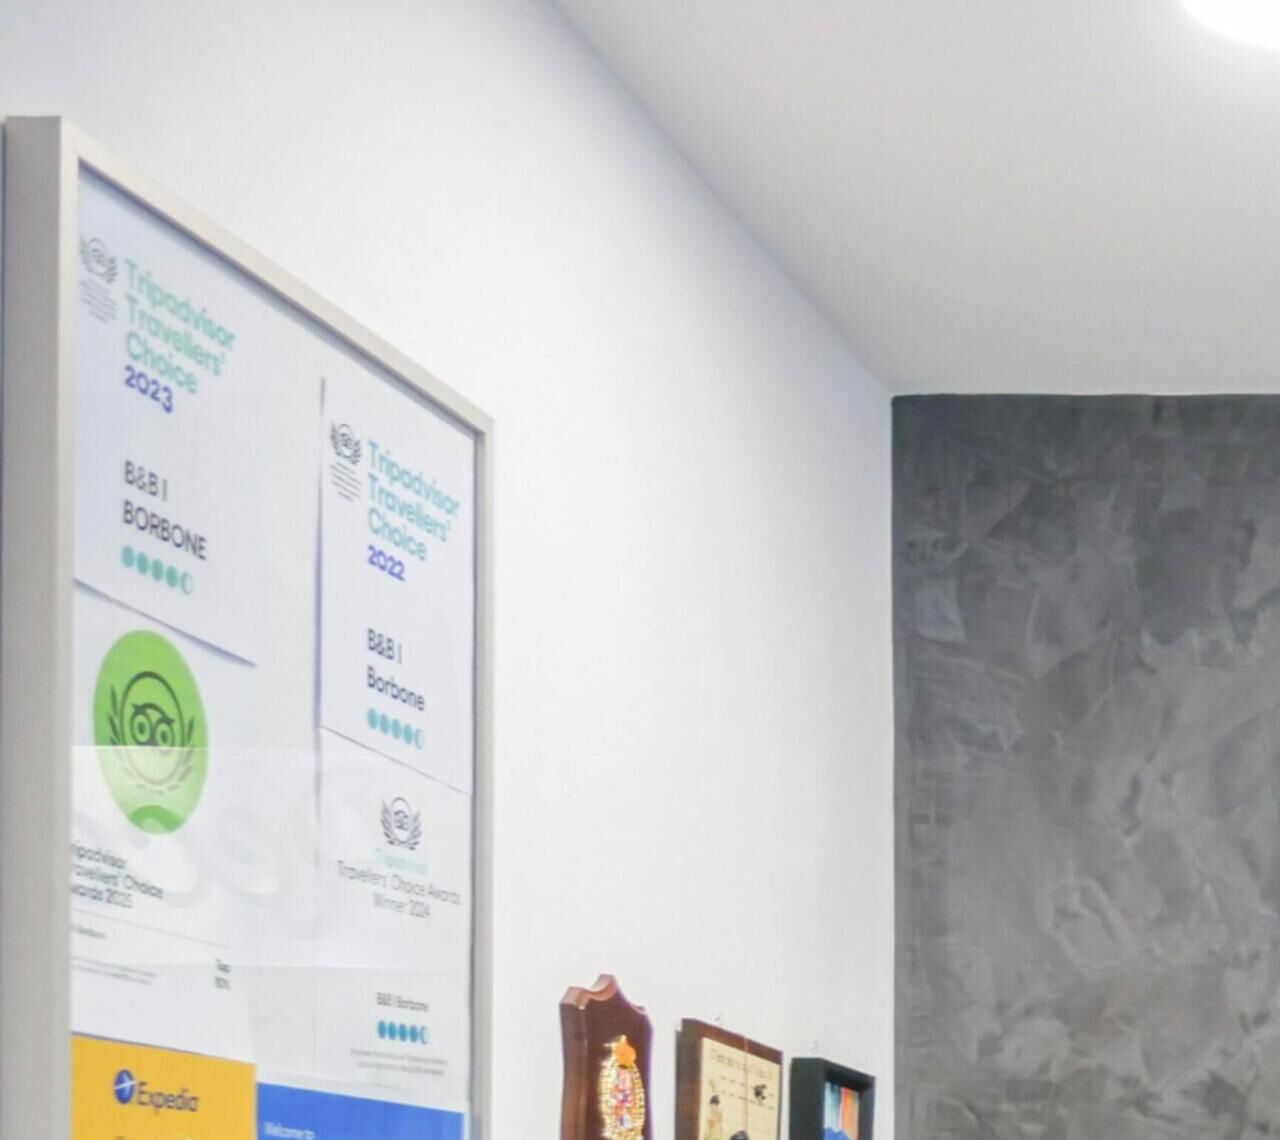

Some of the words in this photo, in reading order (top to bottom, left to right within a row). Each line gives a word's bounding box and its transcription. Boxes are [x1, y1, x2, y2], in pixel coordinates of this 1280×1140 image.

[126, 258, 235, 349] Tripadvisor
[126, 331, 197, 394] Choice
[125, 365, 173, 413] 2023
[124, 461, 160, 496] B&B
[368, 439, 459, 517] Tripadvisor
[123, 501, 207, 560] BORBONE
[368, 507, 427, 562] Choice
[367, 544, 405, 582] 2022
[367, 628, 395, 660] B&B
[367, 665, 425, 711] Borbone
[138, 1081, 200, 1116] Expedia
